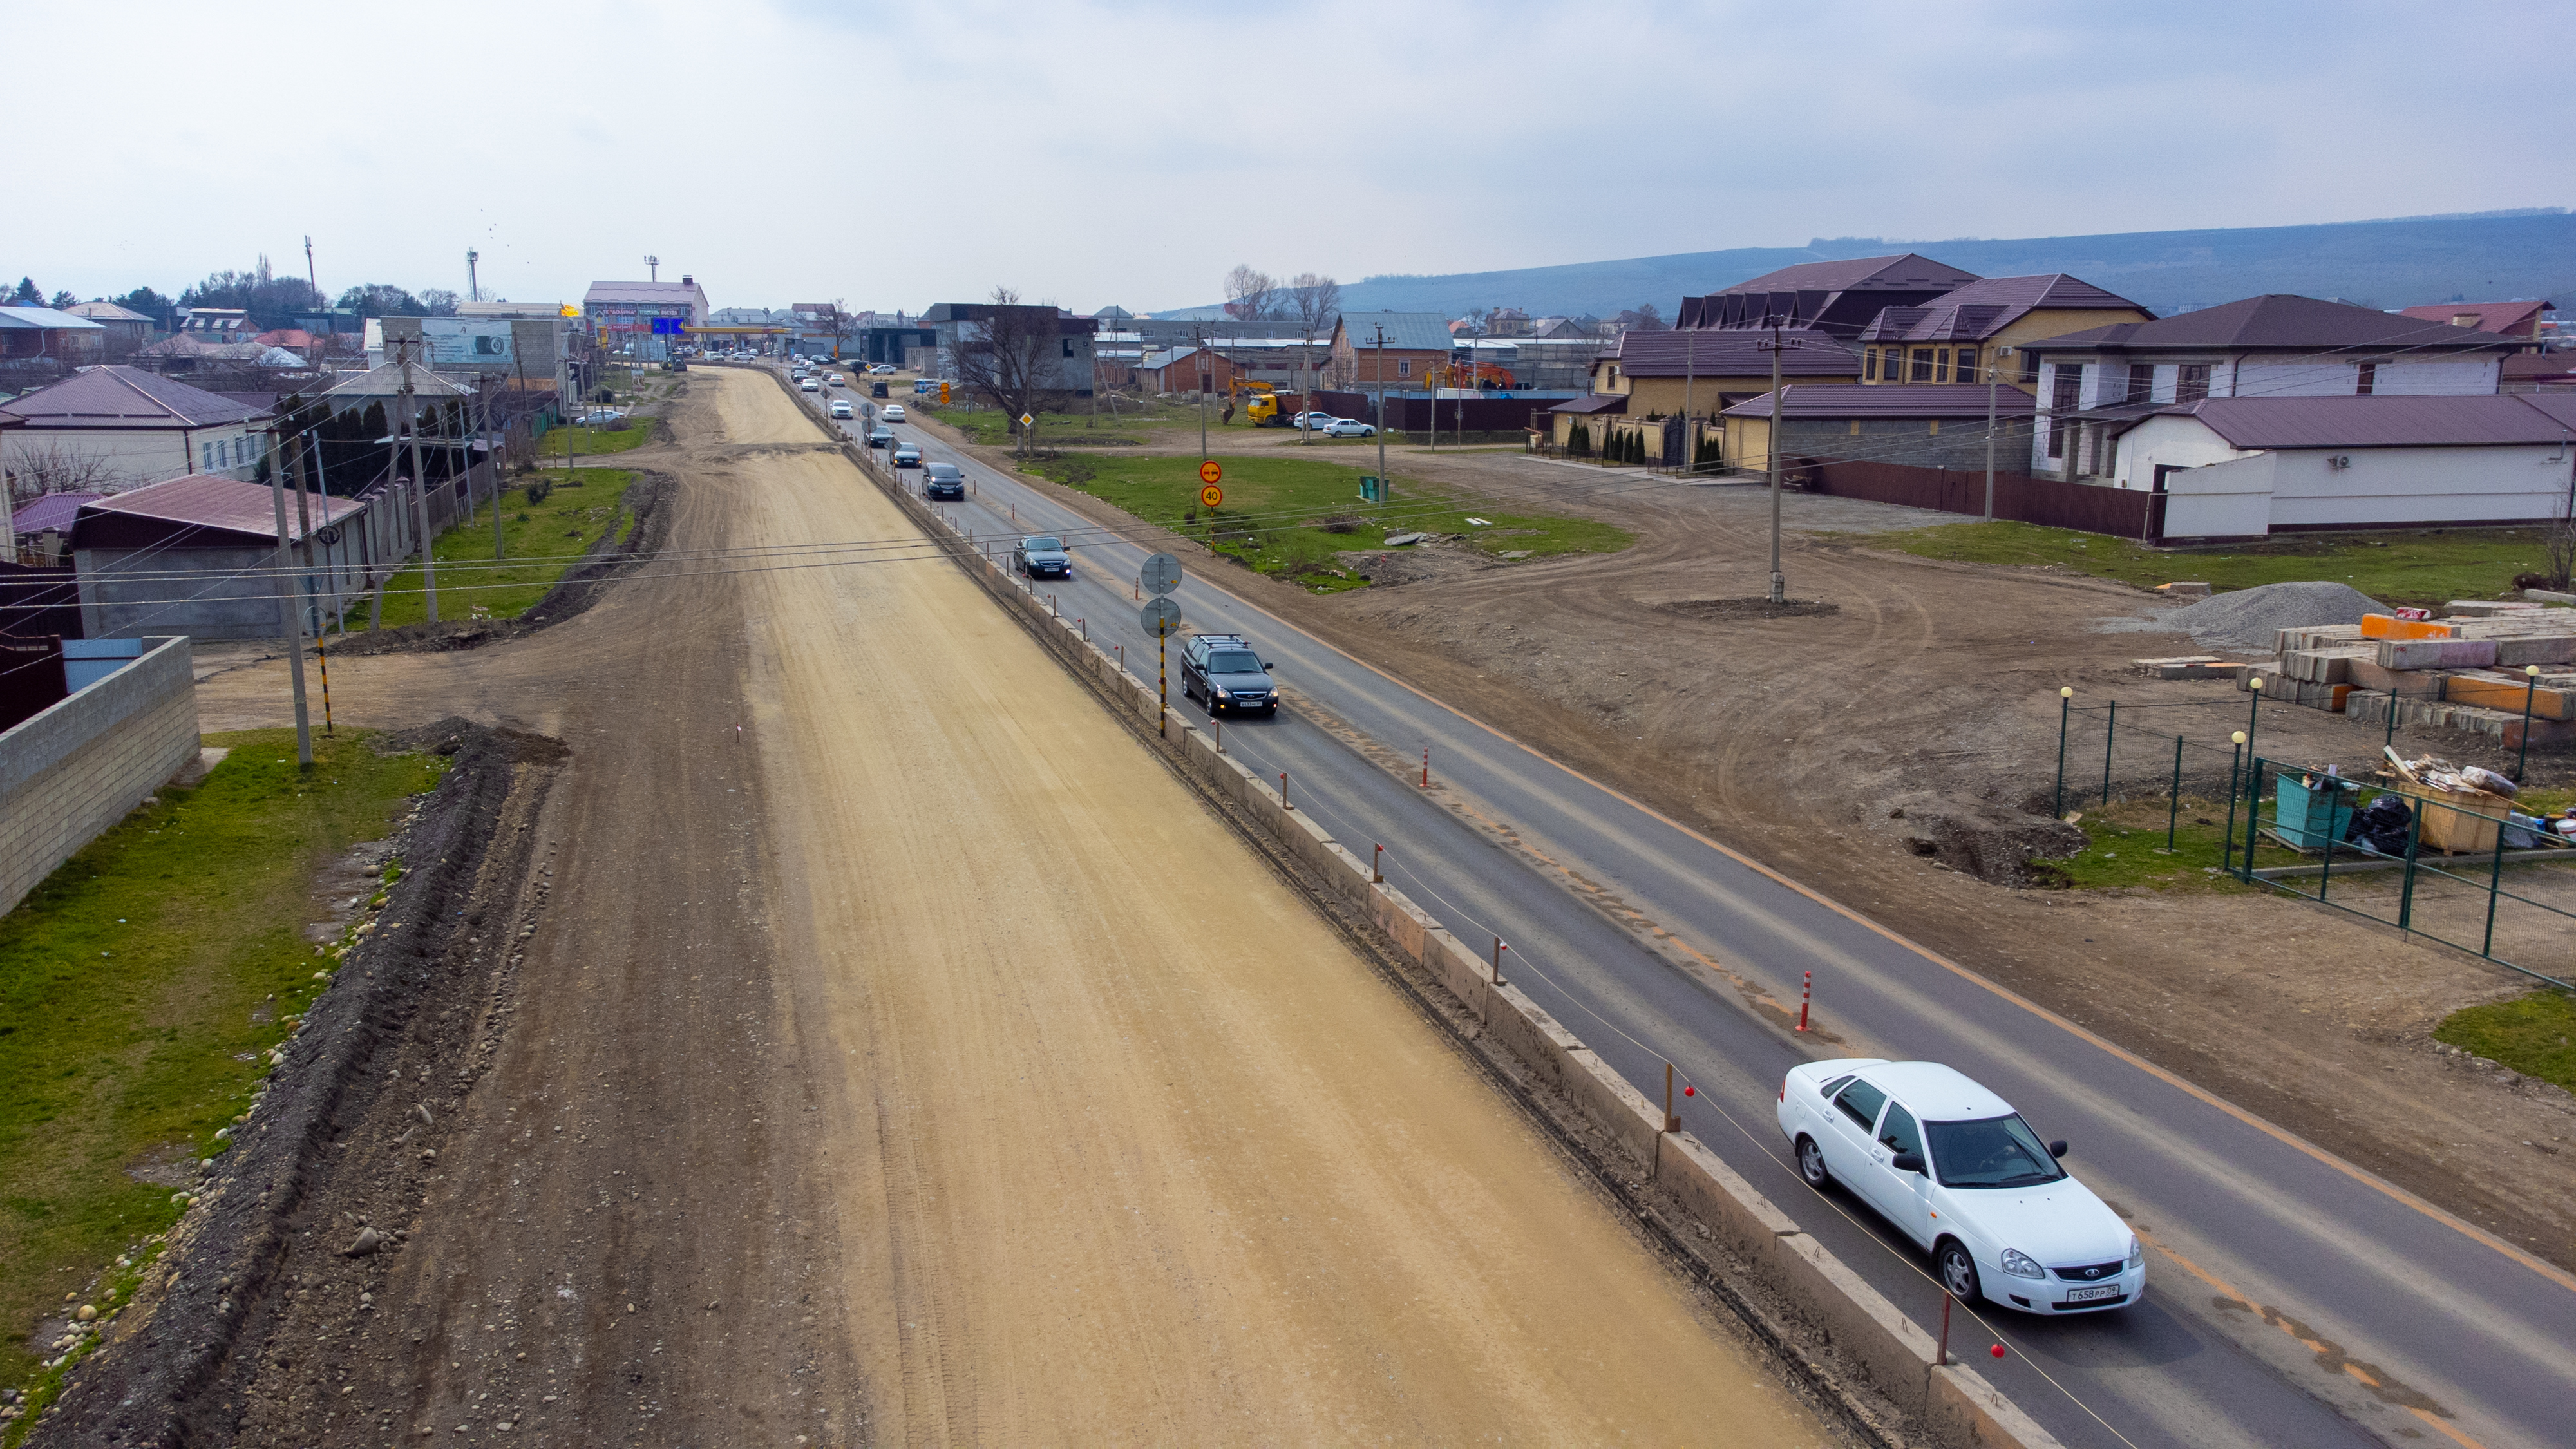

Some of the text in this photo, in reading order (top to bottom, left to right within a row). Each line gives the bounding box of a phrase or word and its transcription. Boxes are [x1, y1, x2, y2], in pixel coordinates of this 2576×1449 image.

[1206, 491, 1218, 500] 40
[2072, 1286, 2116, 1300] Т658РР 09
